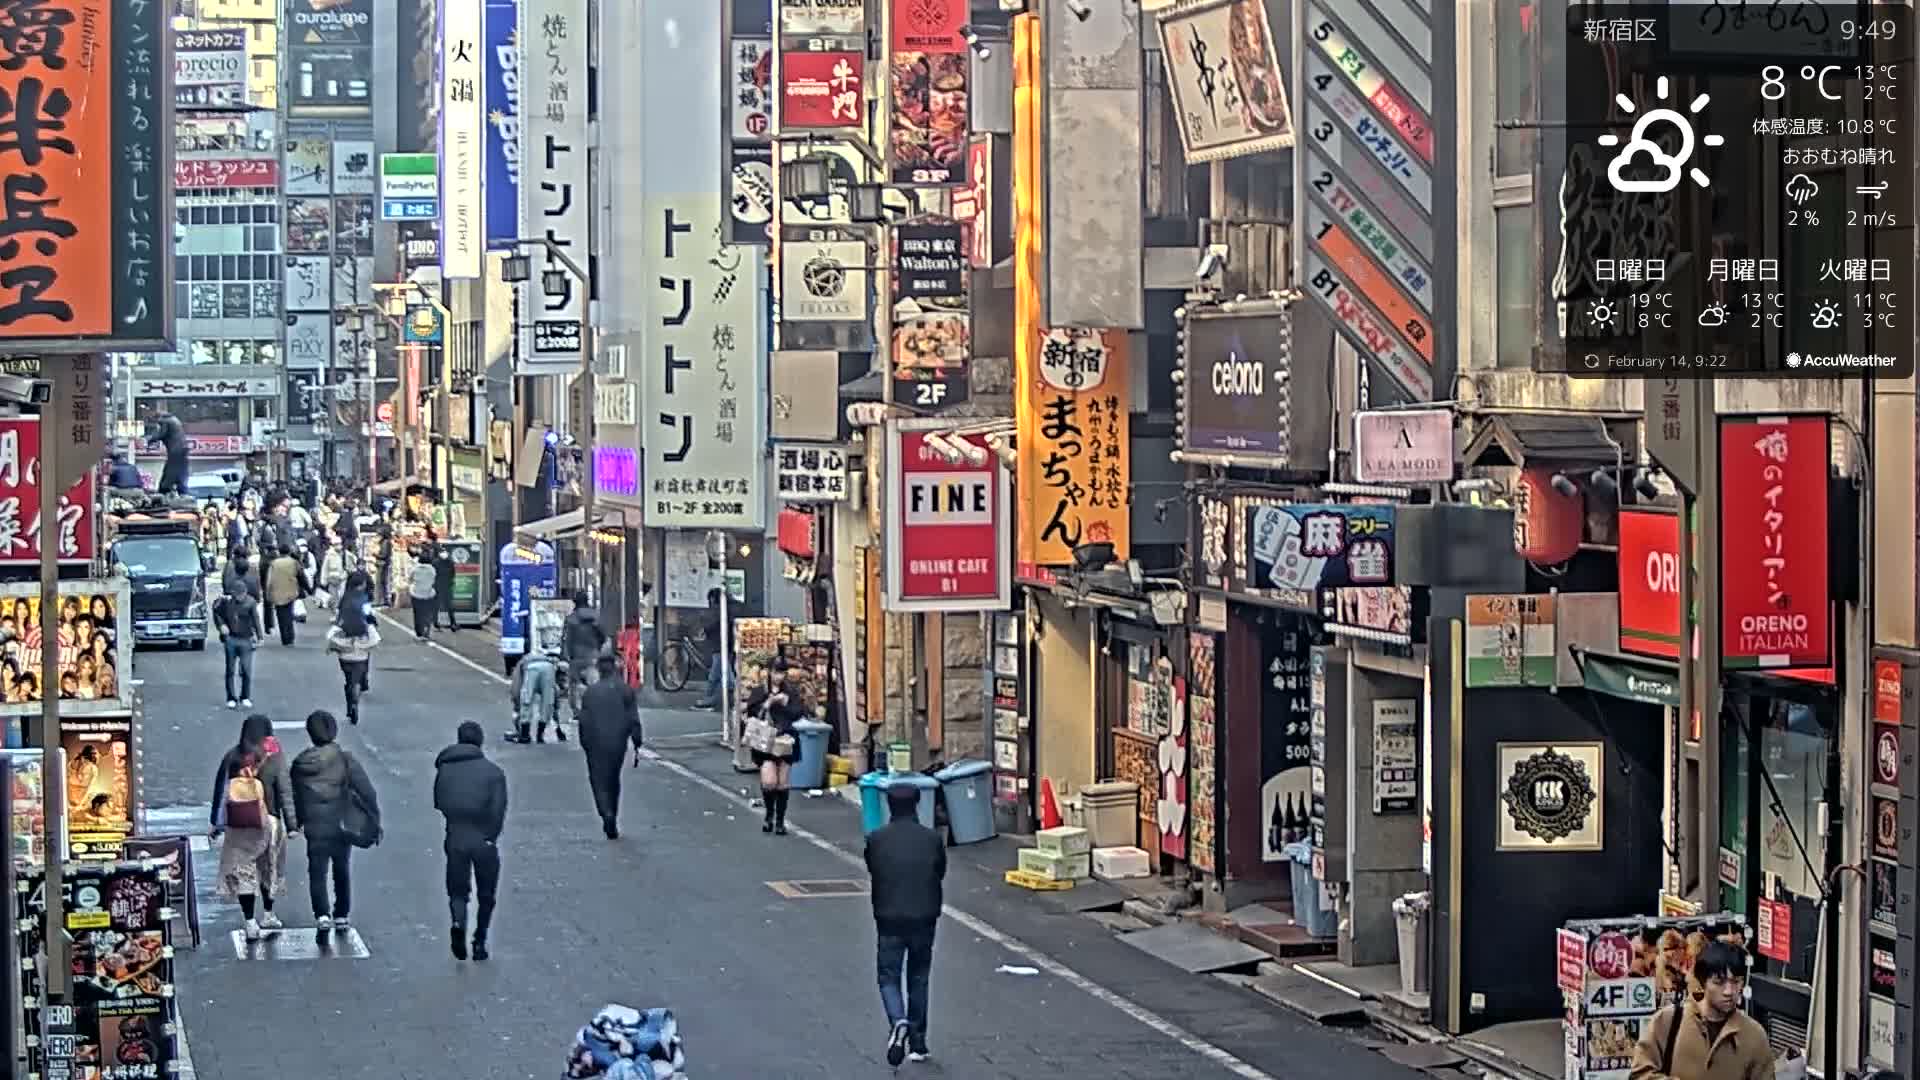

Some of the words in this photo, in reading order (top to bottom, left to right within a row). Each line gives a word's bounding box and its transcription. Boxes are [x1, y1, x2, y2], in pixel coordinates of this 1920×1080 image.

[1314, 21, 1335, 41] 5
[450, 39, 474, 103] 火鍋
[1314, 121, 1334, 142] 3
[1312, 171, 1333, 193] 2
[900, 254, 960, 271] Walton's
[659, 208, 693, 463] トントン
[713, 324, 737, 443] 焼とん酒場
[916, 383, 947, 404] 2F
[71, 353, 93, 445] 通り一番街
[779, 449, 843, 471] 酒場心
[1040, 395, 1085, 548] まっちゃん
[779, 474, 844, 492] 新宿本店
[911, 483, 987, 513] FINE
[1349, 518, 1390, 534] フリー
[1755, 430, 1789, 603] 俺のイタリアン
[909, 559, 954, 575] ONLINE
[958, 559, 989, 574] CAFE
[1647, 551, 1679, 593] OR
[1740, 614, 1808, 632] ORENO
[1739, 633, 1809, 651] ITALIAN
[1591, 985, 1625, 1009] 4F
